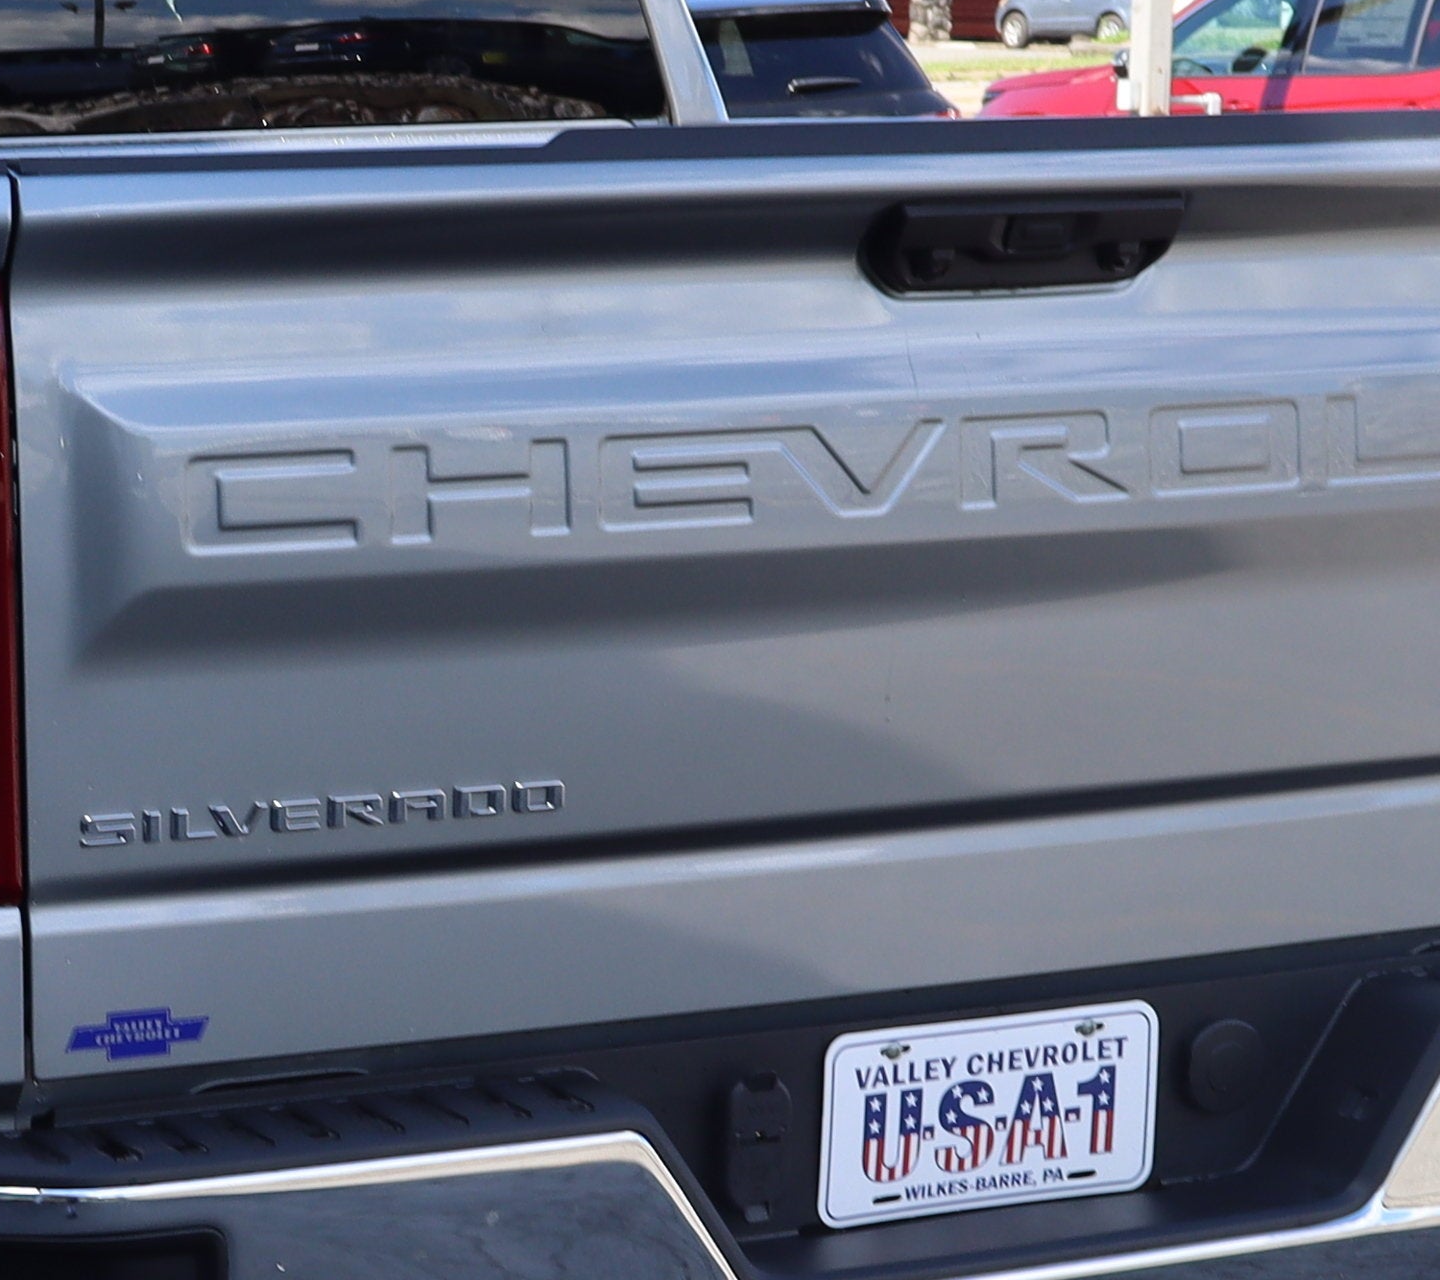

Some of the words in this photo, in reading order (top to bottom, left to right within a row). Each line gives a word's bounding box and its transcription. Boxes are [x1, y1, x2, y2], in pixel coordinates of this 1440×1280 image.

[79, 778, 567, 848] SILVERADO
[94, 1027, 181, 1047] CHEVROLET
[113, 1019, 163, 1034] VALLEY
[855, 1055, 958, 1091] VALLEY
[966, 1036, 1129, 1075] CHEVROLET
[905, 1171, 1038, 1201] WILKES-BARRE,
[1042, 1168, 1065, 1184] PA
